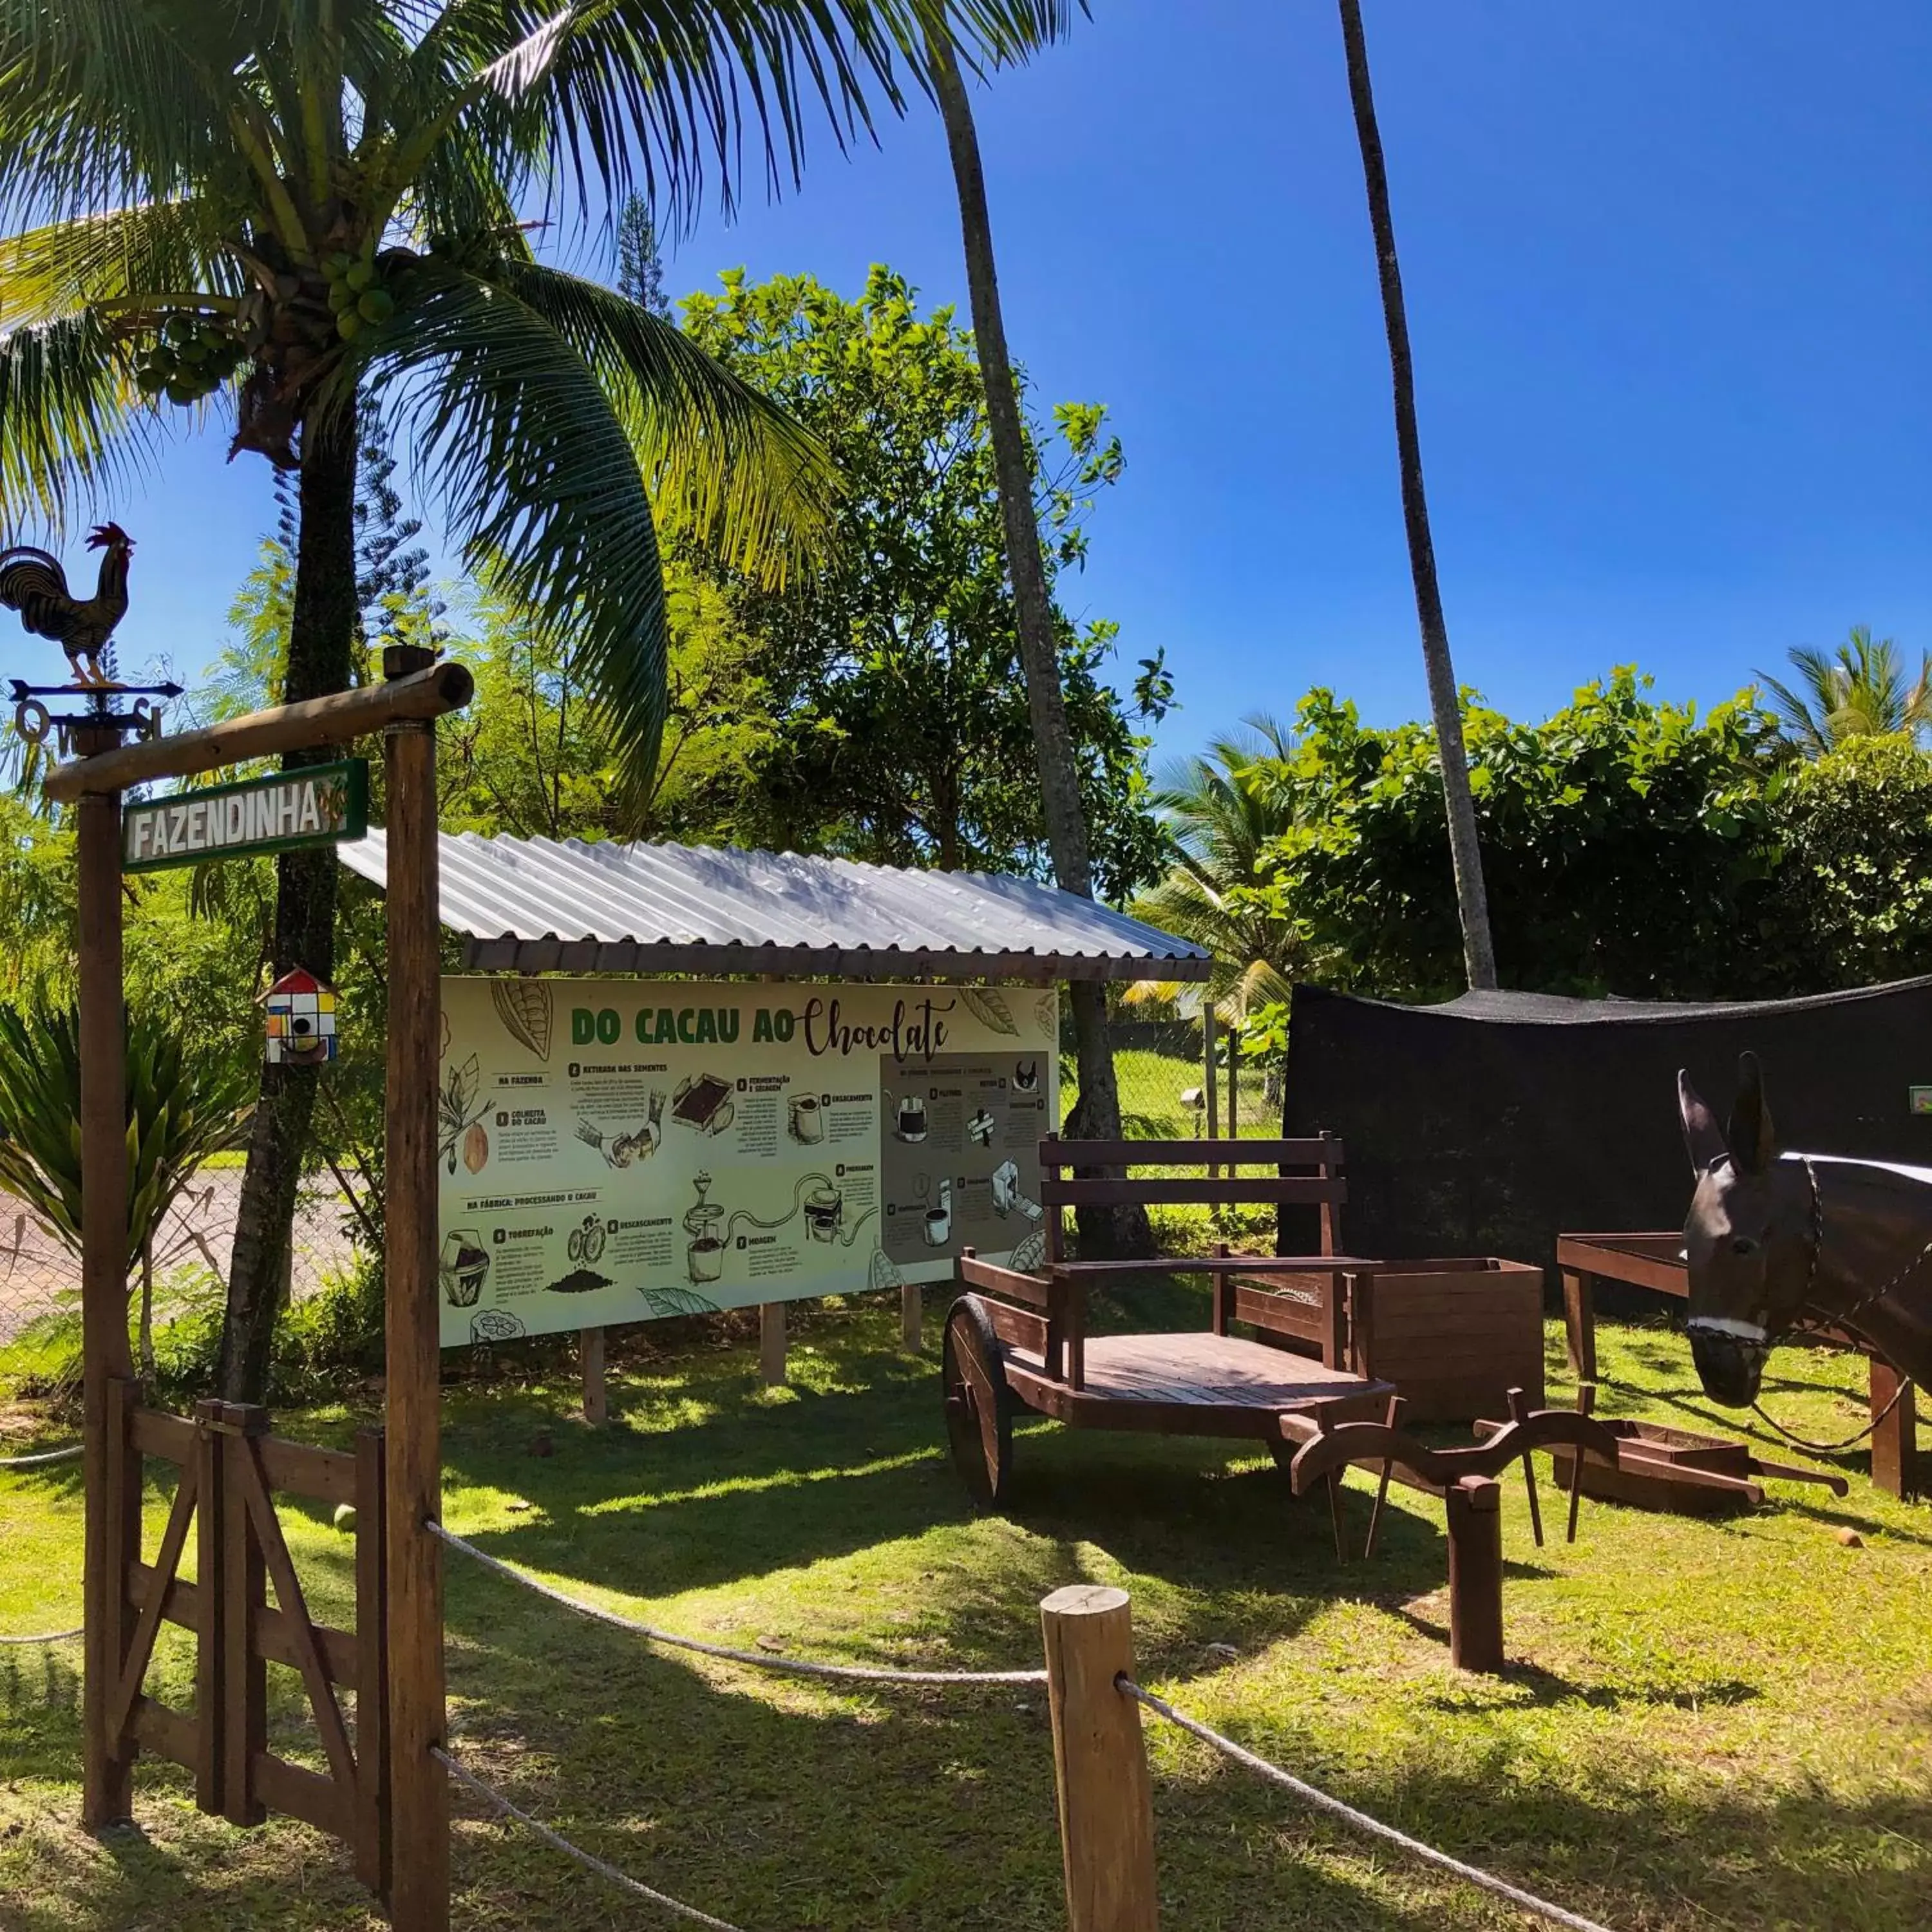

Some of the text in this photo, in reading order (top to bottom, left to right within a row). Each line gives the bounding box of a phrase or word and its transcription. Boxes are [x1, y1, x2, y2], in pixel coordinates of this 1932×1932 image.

[134, 781, 320, 859] FAZENDINHA
[572, 998, 956, 1063] DO CACAU AO Chocolate
[511, 1076, 543, 1084] FAZENDA
[515, 1195, 565, 1206] PROCESSANDO
[575, 1192, 597, 1200] CACAU
[509, 1226, 553, 1239] TORREFAÇÃO
